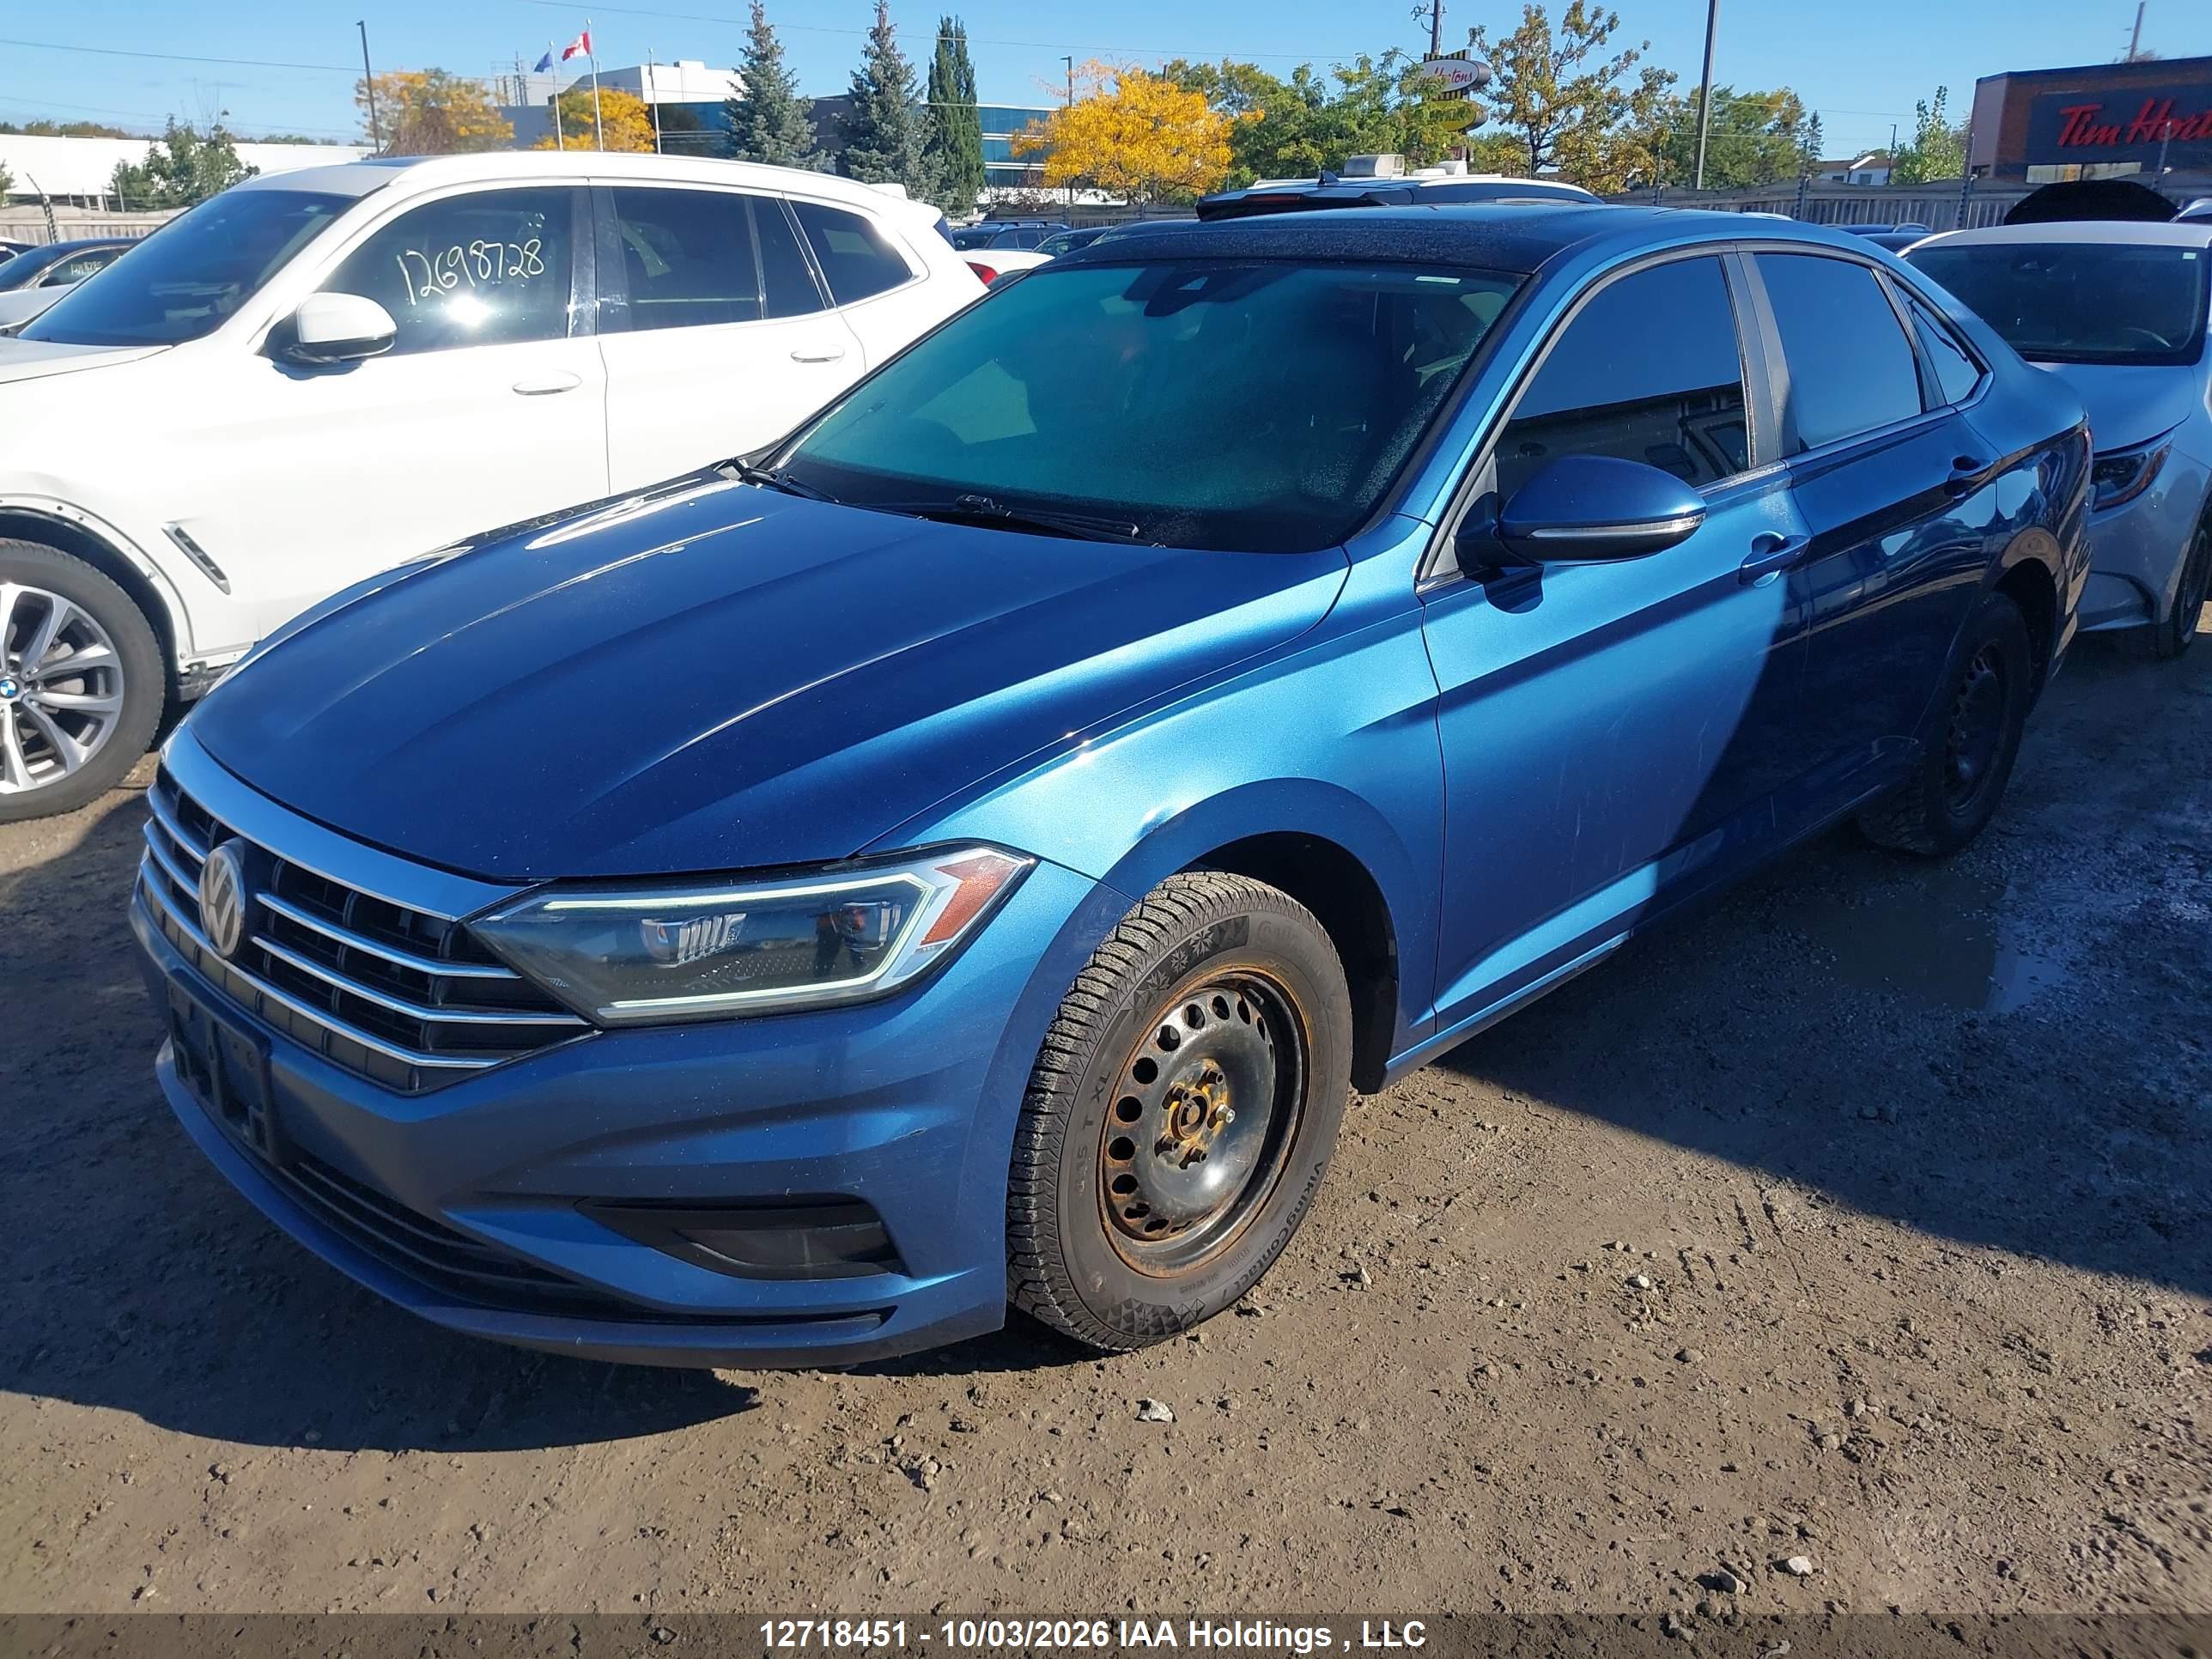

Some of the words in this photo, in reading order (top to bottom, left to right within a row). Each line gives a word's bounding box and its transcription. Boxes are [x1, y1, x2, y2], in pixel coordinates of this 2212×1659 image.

[2057, 103, 2121, 148] Tim
[396, 238, 544, 306] 12698728
[1233, 1160, 1325, 1290] VikingContact
